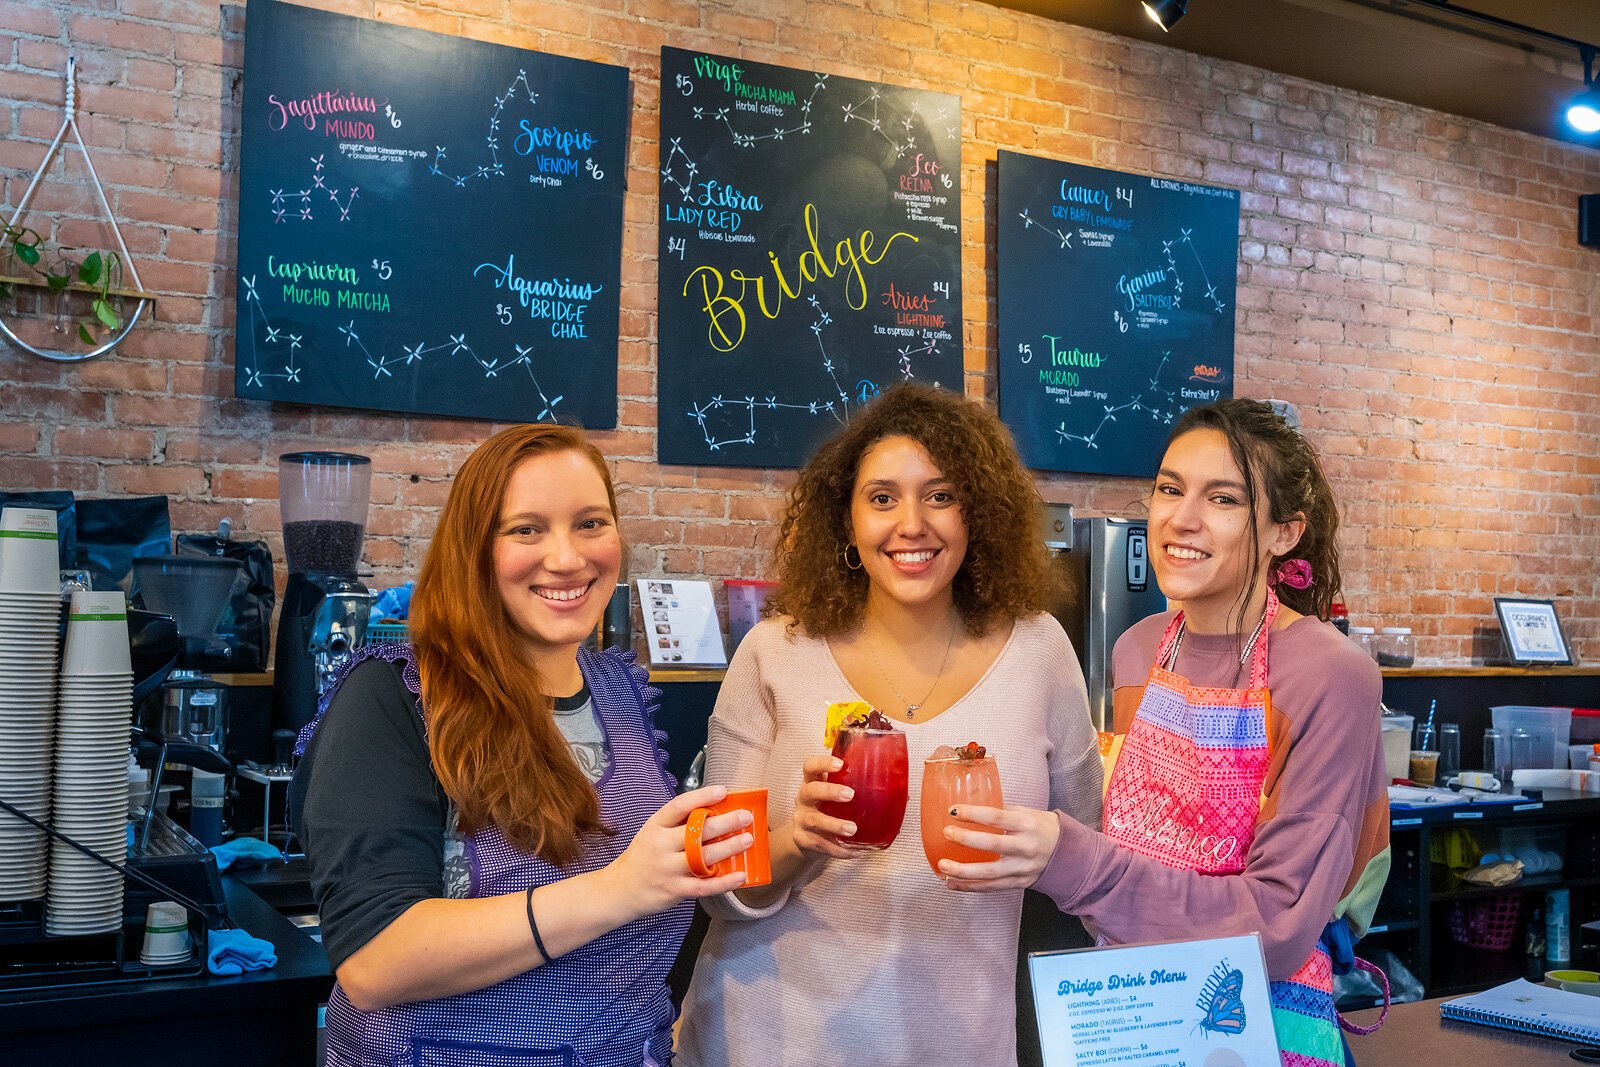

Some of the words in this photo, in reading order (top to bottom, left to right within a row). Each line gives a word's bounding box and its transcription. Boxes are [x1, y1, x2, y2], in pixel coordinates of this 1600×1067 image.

[676, 73, 693, 97] $5
[734, 82, 767, 104] PACHA
[769, 88, 796, 106] MAMA
[268, 88, 388, 131] Sagittarius
[385, 104, 401, 128] $6
[735, 100, 758, 113] Herbal
[760, 104, 784, 117] coffee
[325, 119, 375, 140] MUNDO
[513, 119, 598, 156] Scorpio
[364, 145, 377, 153] and
[536, 153, 579, 178] VENOM
[585, 157, 604, 180] $6
[909, 153, 945, 177] Leo
[529, 174, 547, 188] Dirty
[899, 175, 934, 193] REINA
[940, 174, 953, 189] $6
[1150, 177, 1160, 189] ALL
[1160, 180, 1181, 191] DRINKS
[697, 180, 763, 212] Libra
[1060, 178, 1114, 212] Cancer
[1116, 186, 1133, 209] $4
[666, 204, 704, 227] LADY
[707, 209, 741, 233] RED
[1052, 204, 1069, 221] CRY
[1069, 206, 1091, 224] BABY
[1091, 214, 1134, 231] LEMONADE
[698, 230, 723, 241] Hibiscus
[667, 236, 686, 261] $4
[268, 255, 360, 286] Capricorn
[371, 258, 393, 280] $5
[473, 254, 603, 307] Aquarius
[683, 203, 919, 352] Bridge
[283, 284, 330, 307] MUCHO
[337, 289, 391, 313] MATCHA
[881, 282, 937, 312] Aries
[933, 281, 949, 300] $4
[1116, 265, 1167, 312] Gemini
[530, 298, 588, 323] BRIDGE
[1135, 293, 1158, 308] SALTY
[1158, 294, 1173, 310] BOI
[495, 303, 513, 325] $5
[897, 312, 946, 329] LIGHTNING
[1114, 310, 1129, 333] $6
[551, 322, 588, 339] CHAI
[886, 326, 915, 337] espresso
[933, 330, 953, 340] coffee
[1018, 343, 1033, 364] $5
[1042, 334, 1108, 368] Taurus
[1181, 387, 1198, 400] Extra
[1057, 978, 1104, 997] Bridge
[1107, 972, 1146, 990] Drink
[1150, 969, 1187, 986] Menu
[1196, 957, 1234, 1014] BRIDGE
[1067, 999, 1100, 1009] LIGHTNING
[1101, 997, 1121, 1006] (ARIES)
[1070, 1021, 1099, 1030] MORADO
[1100, 1017, 1126, 1028] (TAURUS)
[1134, 1015, 1142, 1023] $5
[1144, 1021, 1168, 1029] LAVENDER
[1075, 1050, 1094, 1059] SALTY
[1142, 1050, 1164, 1058] CARAMEL
